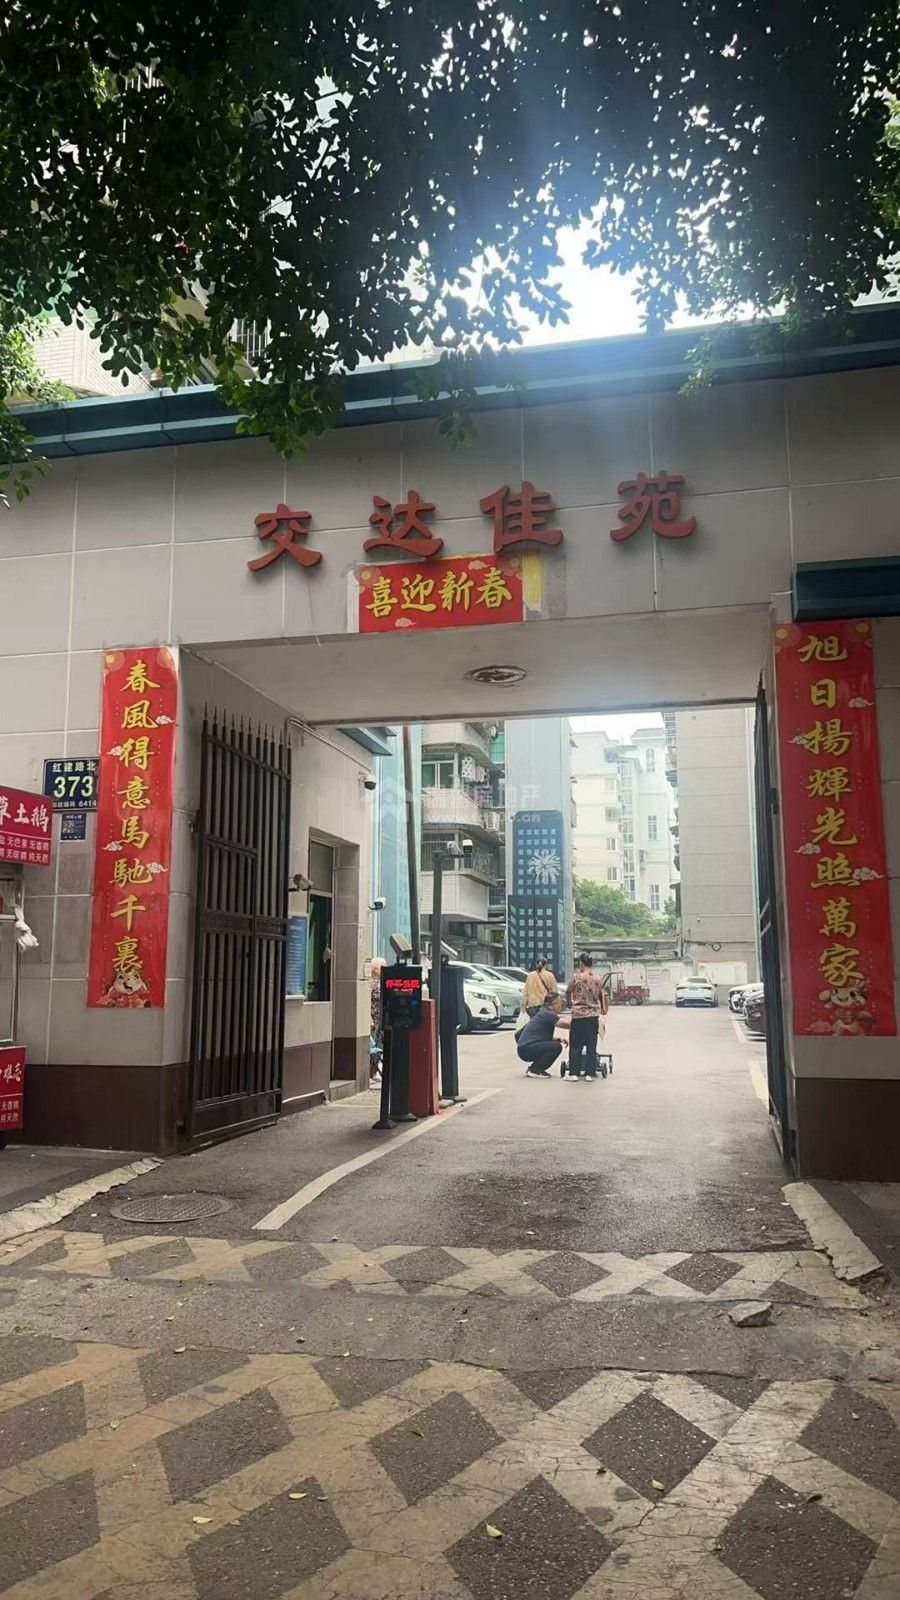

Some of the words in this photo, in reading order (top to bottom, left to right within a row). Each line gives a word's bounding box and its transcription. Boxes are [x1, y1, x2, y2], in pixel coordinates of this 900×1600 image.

[248, 470, 697, 571] 交达佳苑
[365, 567, 512, 617] 喜迎新春
[53, 775, 94, 798] 373
[798, 635, 865, 987] 旭日揚輝光照萬家
